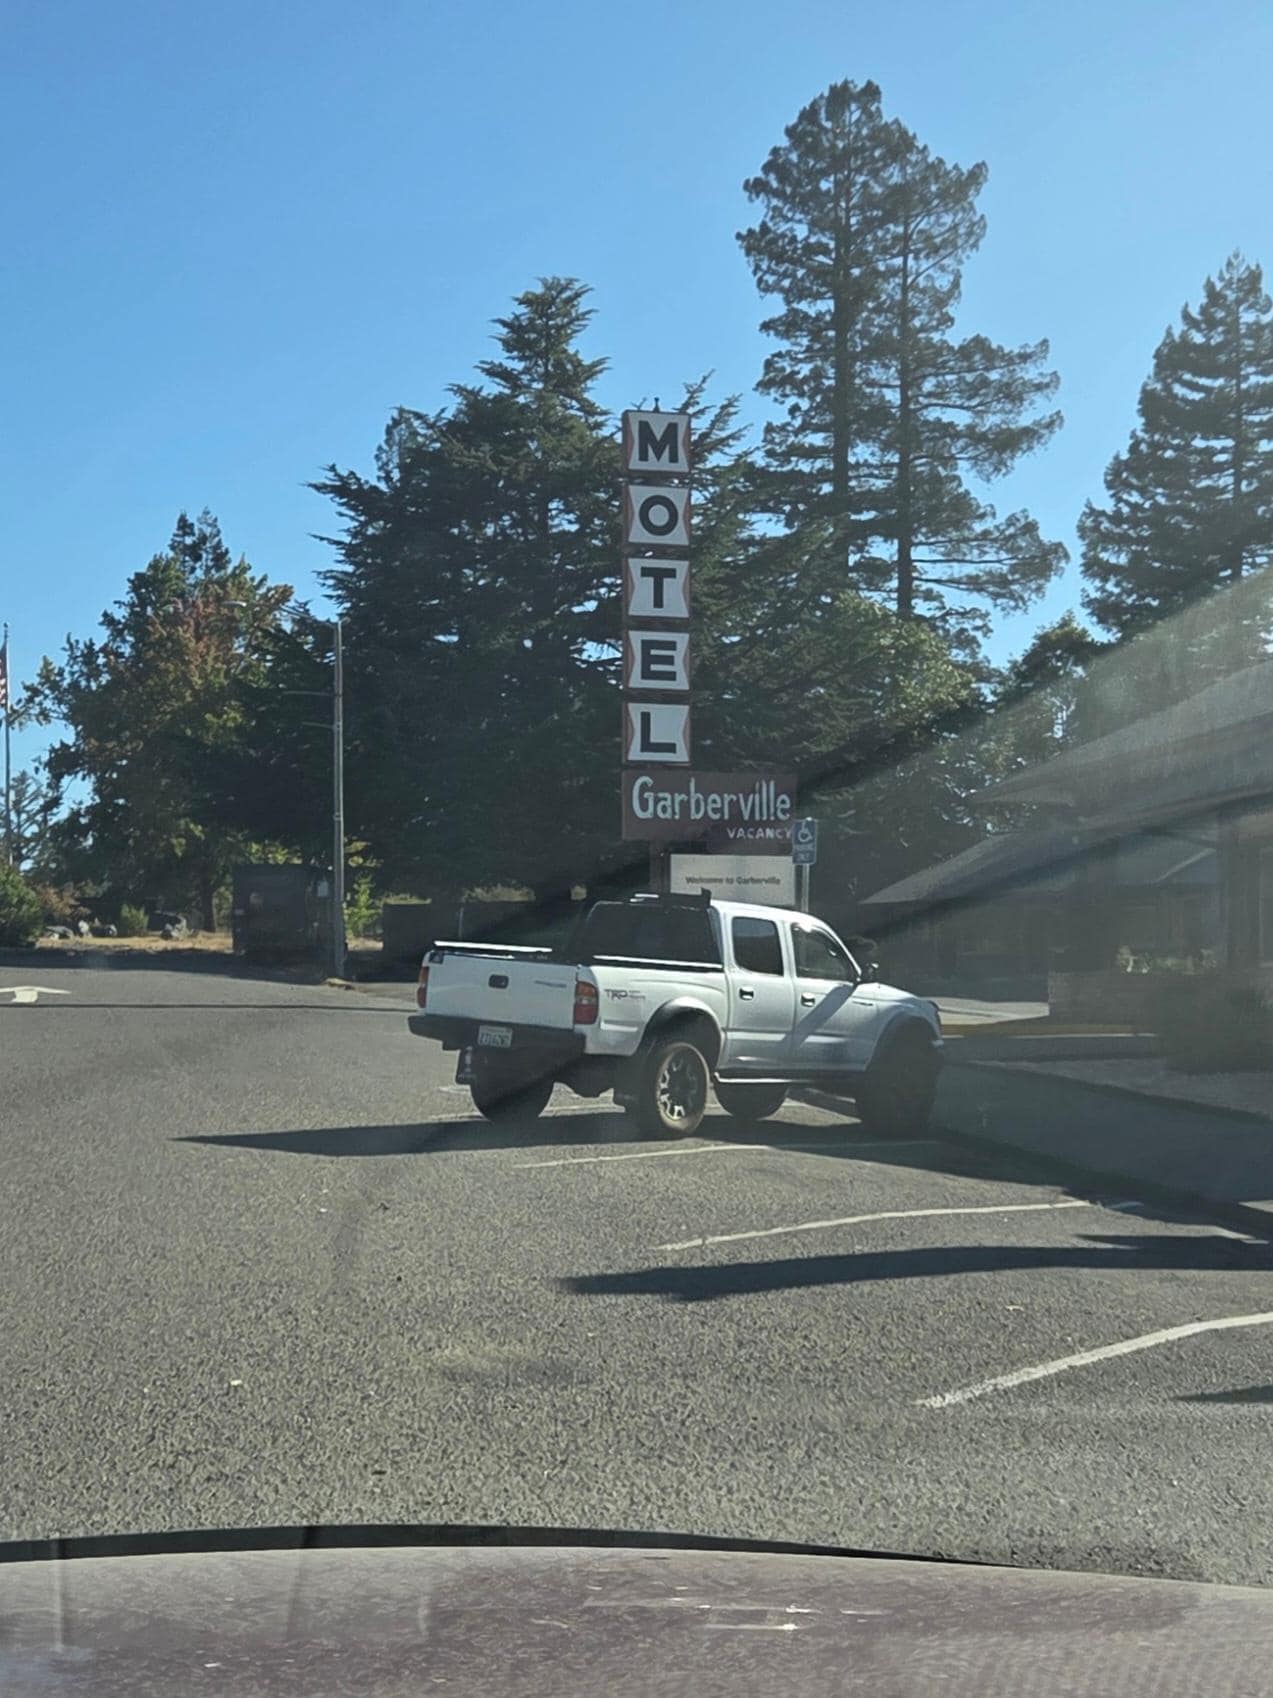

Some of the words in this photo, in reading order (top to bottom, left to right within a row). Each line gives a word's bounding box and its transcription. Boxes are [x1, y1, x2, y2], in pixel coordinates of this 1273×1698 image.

[638, 420, 679, 755] MOTEL
[632, 775, 791, 821] Garberville
[727, 827, 792, 840] VACANCY
